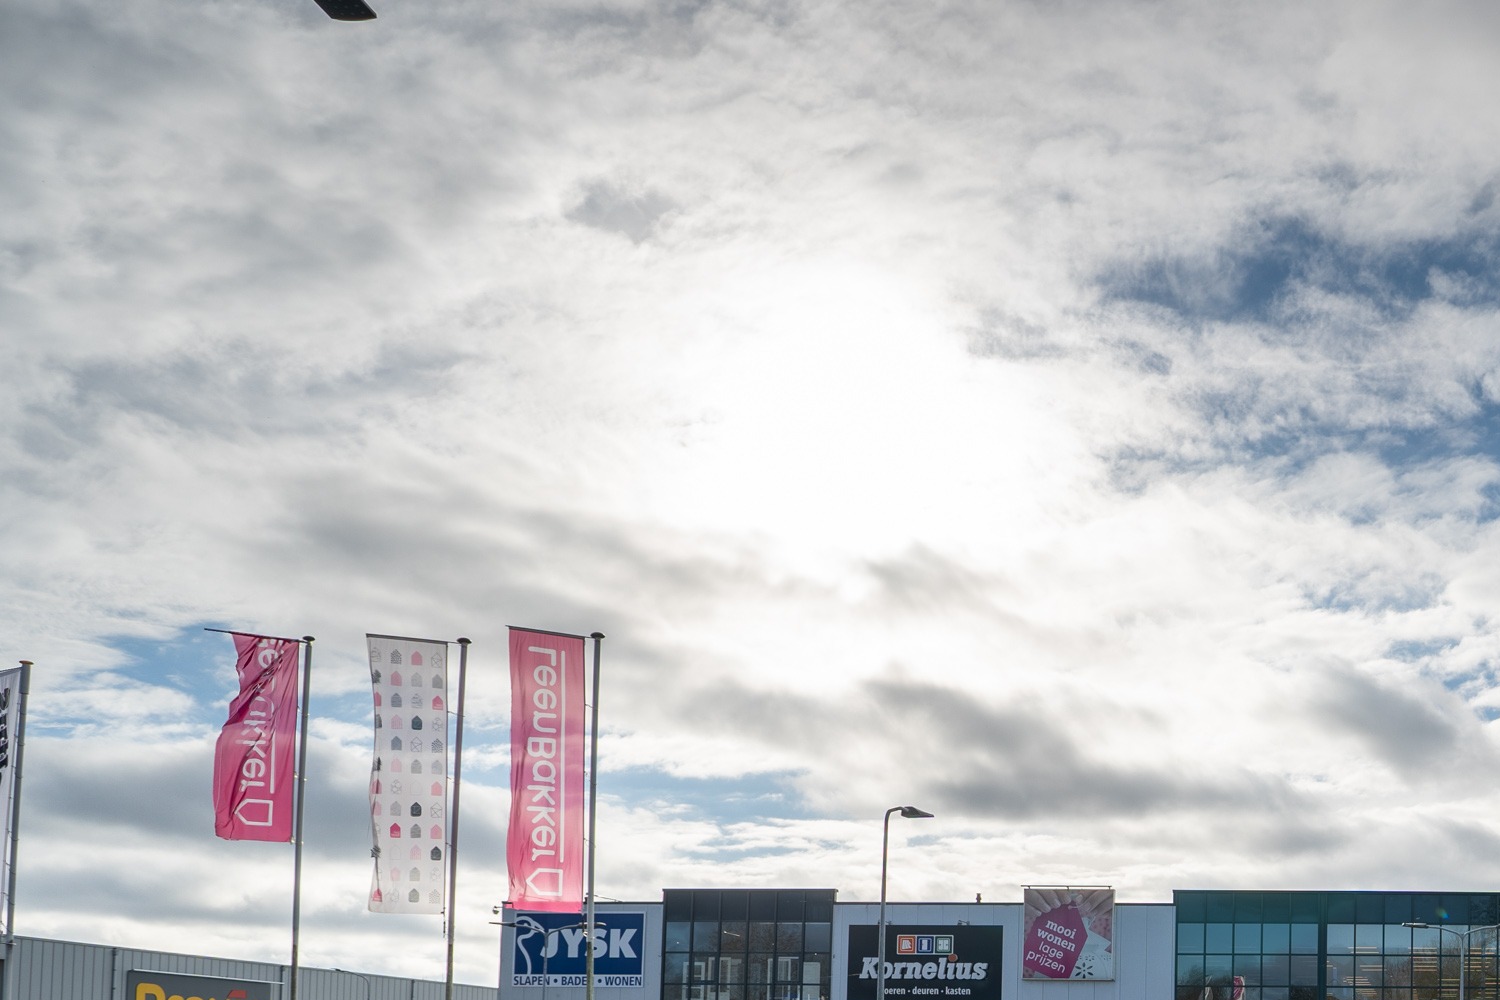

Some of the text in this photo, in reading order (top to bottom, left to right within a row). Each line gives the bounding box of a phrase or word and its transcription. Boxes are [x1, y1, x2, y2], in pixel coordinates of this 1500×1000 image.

[1045, 920, 1077, 939] mooi
[540, 928, 638, 959] JYSK
[1037, 928, 1076, 952] wonen
[1039, 941, 1064, 959] lage
[859, 954, 989, 980] Kornelius
[1026, 951, 1066, 973] prijzen
[513, 976, 642, 987] SLAPEN BADE WONEN
[884, 986, 971, 996] oeren deuren kasten
